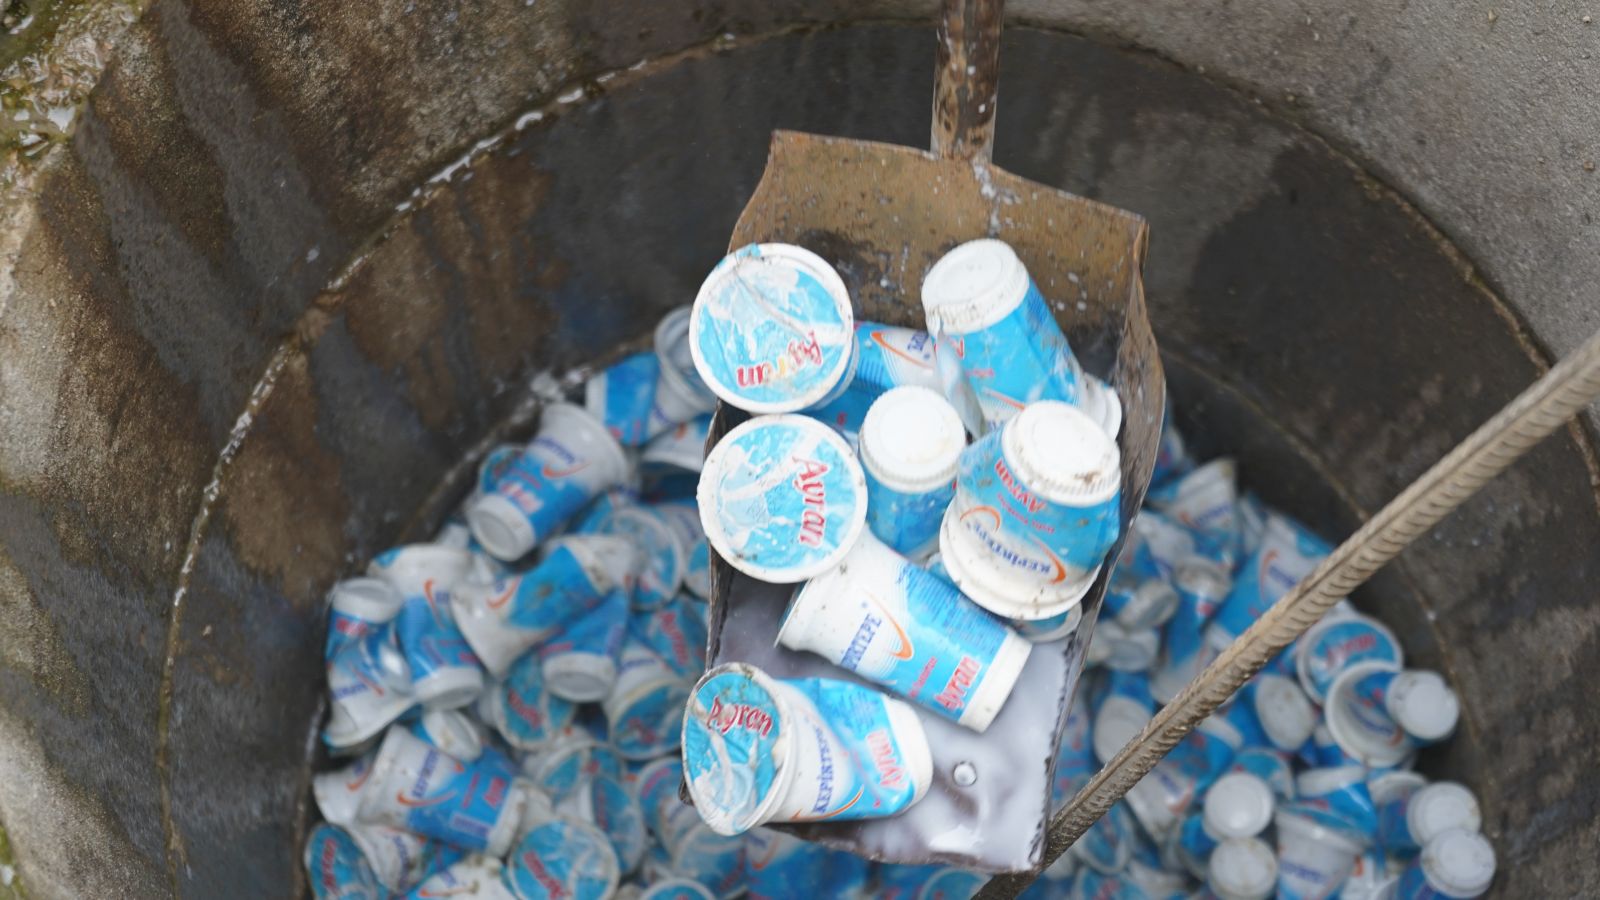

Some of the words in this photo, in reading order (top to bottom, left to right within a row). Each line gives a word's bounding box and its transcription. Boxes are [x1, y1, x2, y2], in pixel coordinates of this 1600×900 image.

[736, 331, 823, 388] Ayran
[792, 455, 829, 547] Ayran
[994, 459, 1045, 513] Ayran
[934, 656, 981, 711] Ayran
[706, 696, 773, 737] Ayran
